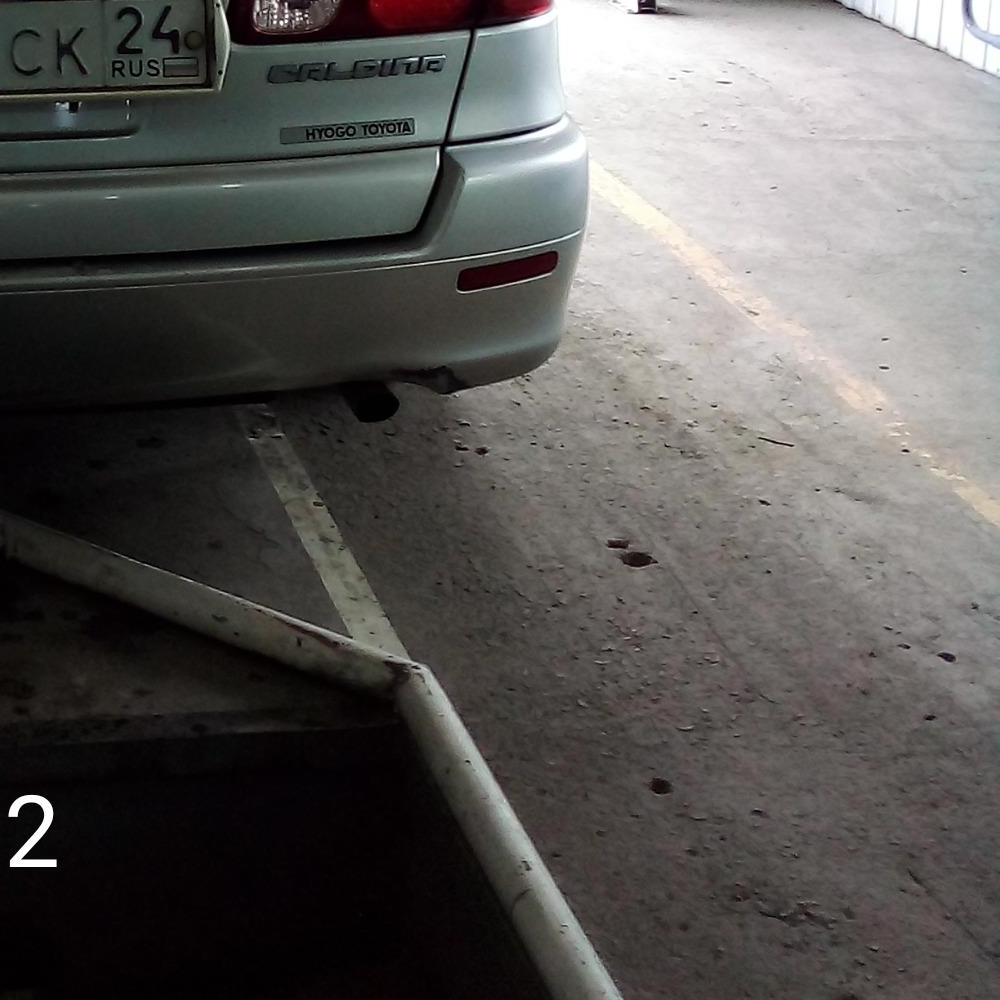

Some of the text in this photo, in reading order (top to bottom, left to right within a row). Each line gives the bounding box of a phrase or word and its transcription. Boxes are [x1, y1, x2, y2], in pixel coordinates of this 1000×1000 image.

[116, 5, 181, 55] 24
[111, 60, 161, 79] RUS
[306, 121, 412, 141] HYOGO TOYOTA
